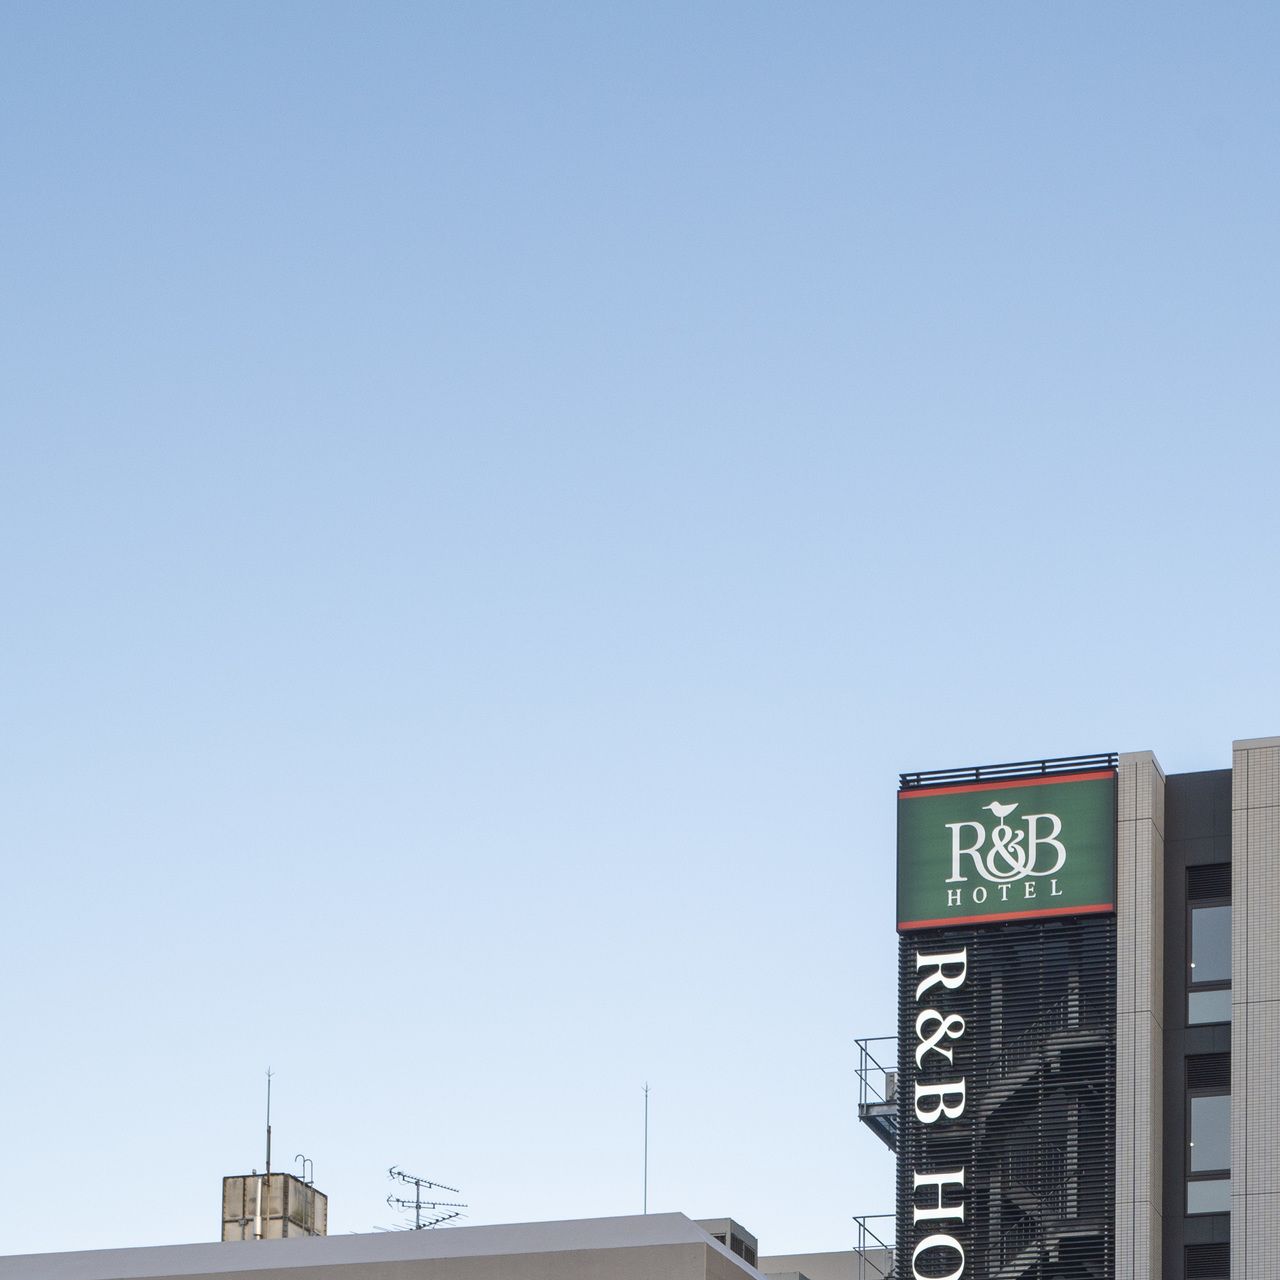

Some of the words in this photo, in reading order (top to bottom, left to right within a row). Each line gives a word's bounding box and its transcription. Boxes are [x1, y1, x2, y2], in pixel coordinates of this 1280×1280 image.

[945, 813, 1067, 883] R&B
[946, 879, 1063, 907] HOTEL
[914, 946, 968, 1125] R&B
